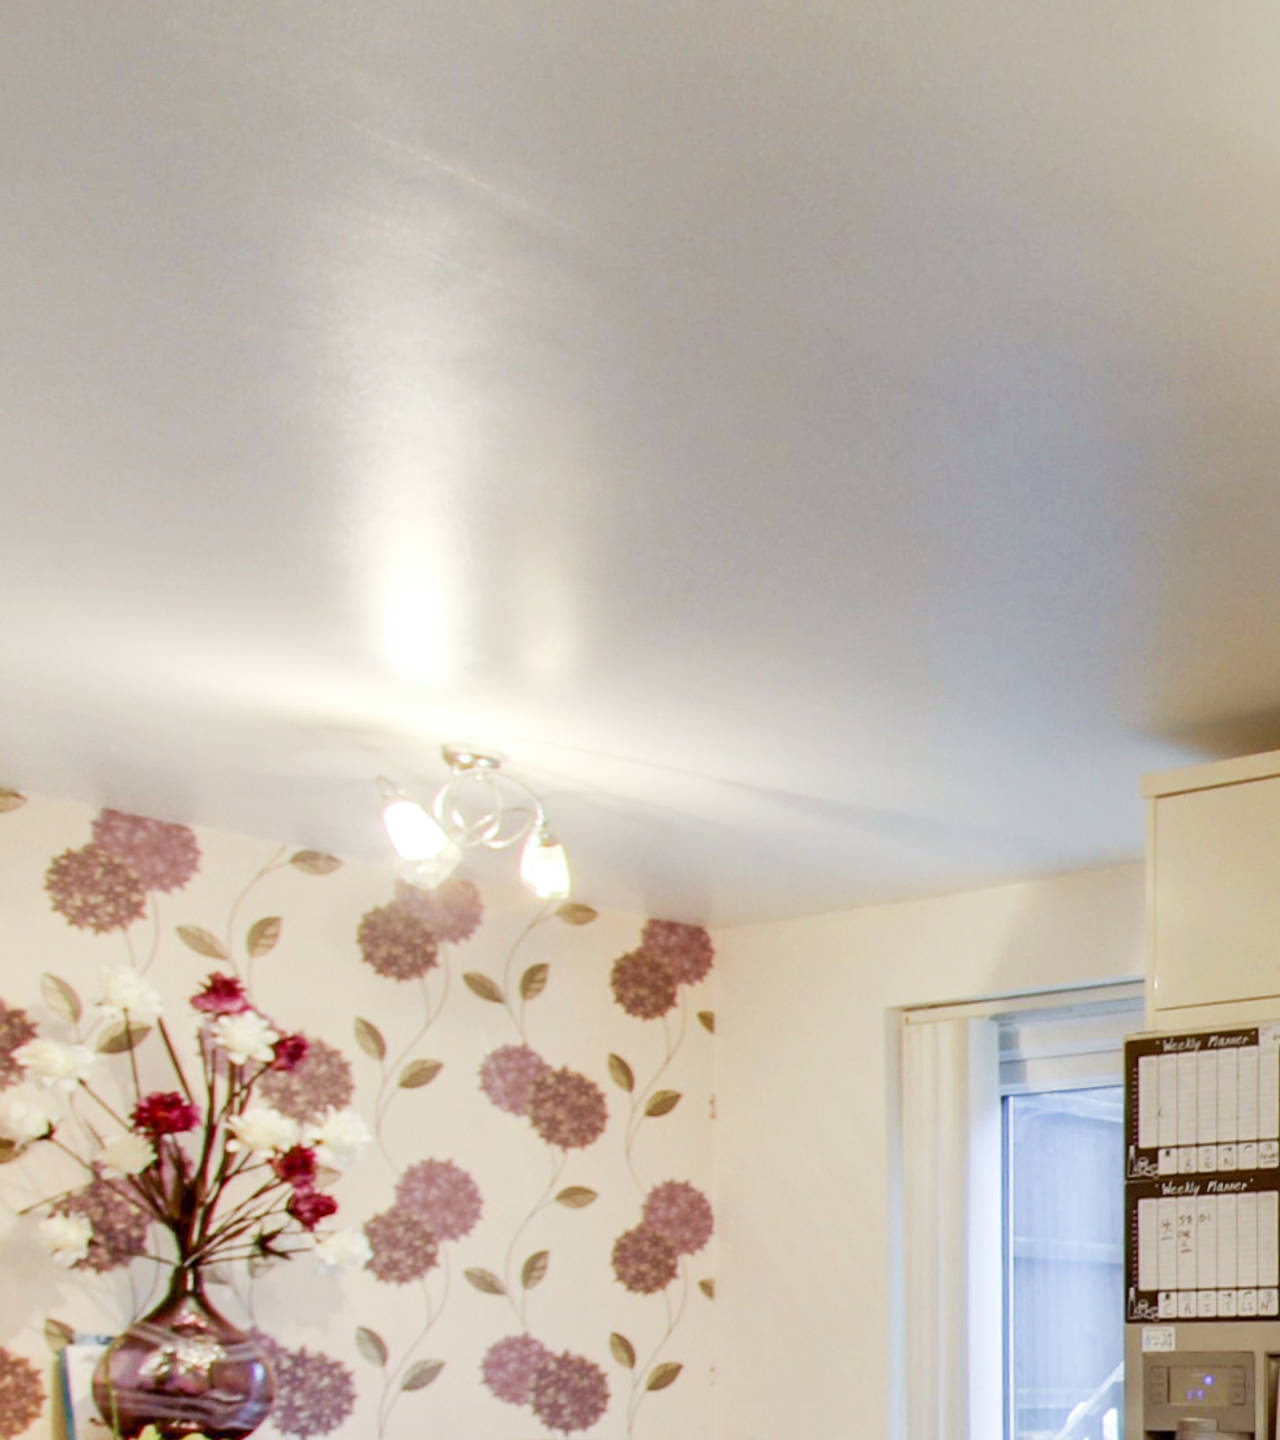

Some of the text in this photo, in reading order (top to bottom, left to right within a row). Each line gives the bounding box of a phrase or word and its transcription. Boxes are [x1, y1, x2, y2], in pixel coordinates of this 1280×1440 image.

[1162, 1034, 1249, 1053] Weekly Planner
[1161, 1179, 1248, 1196] Weekly Planner
